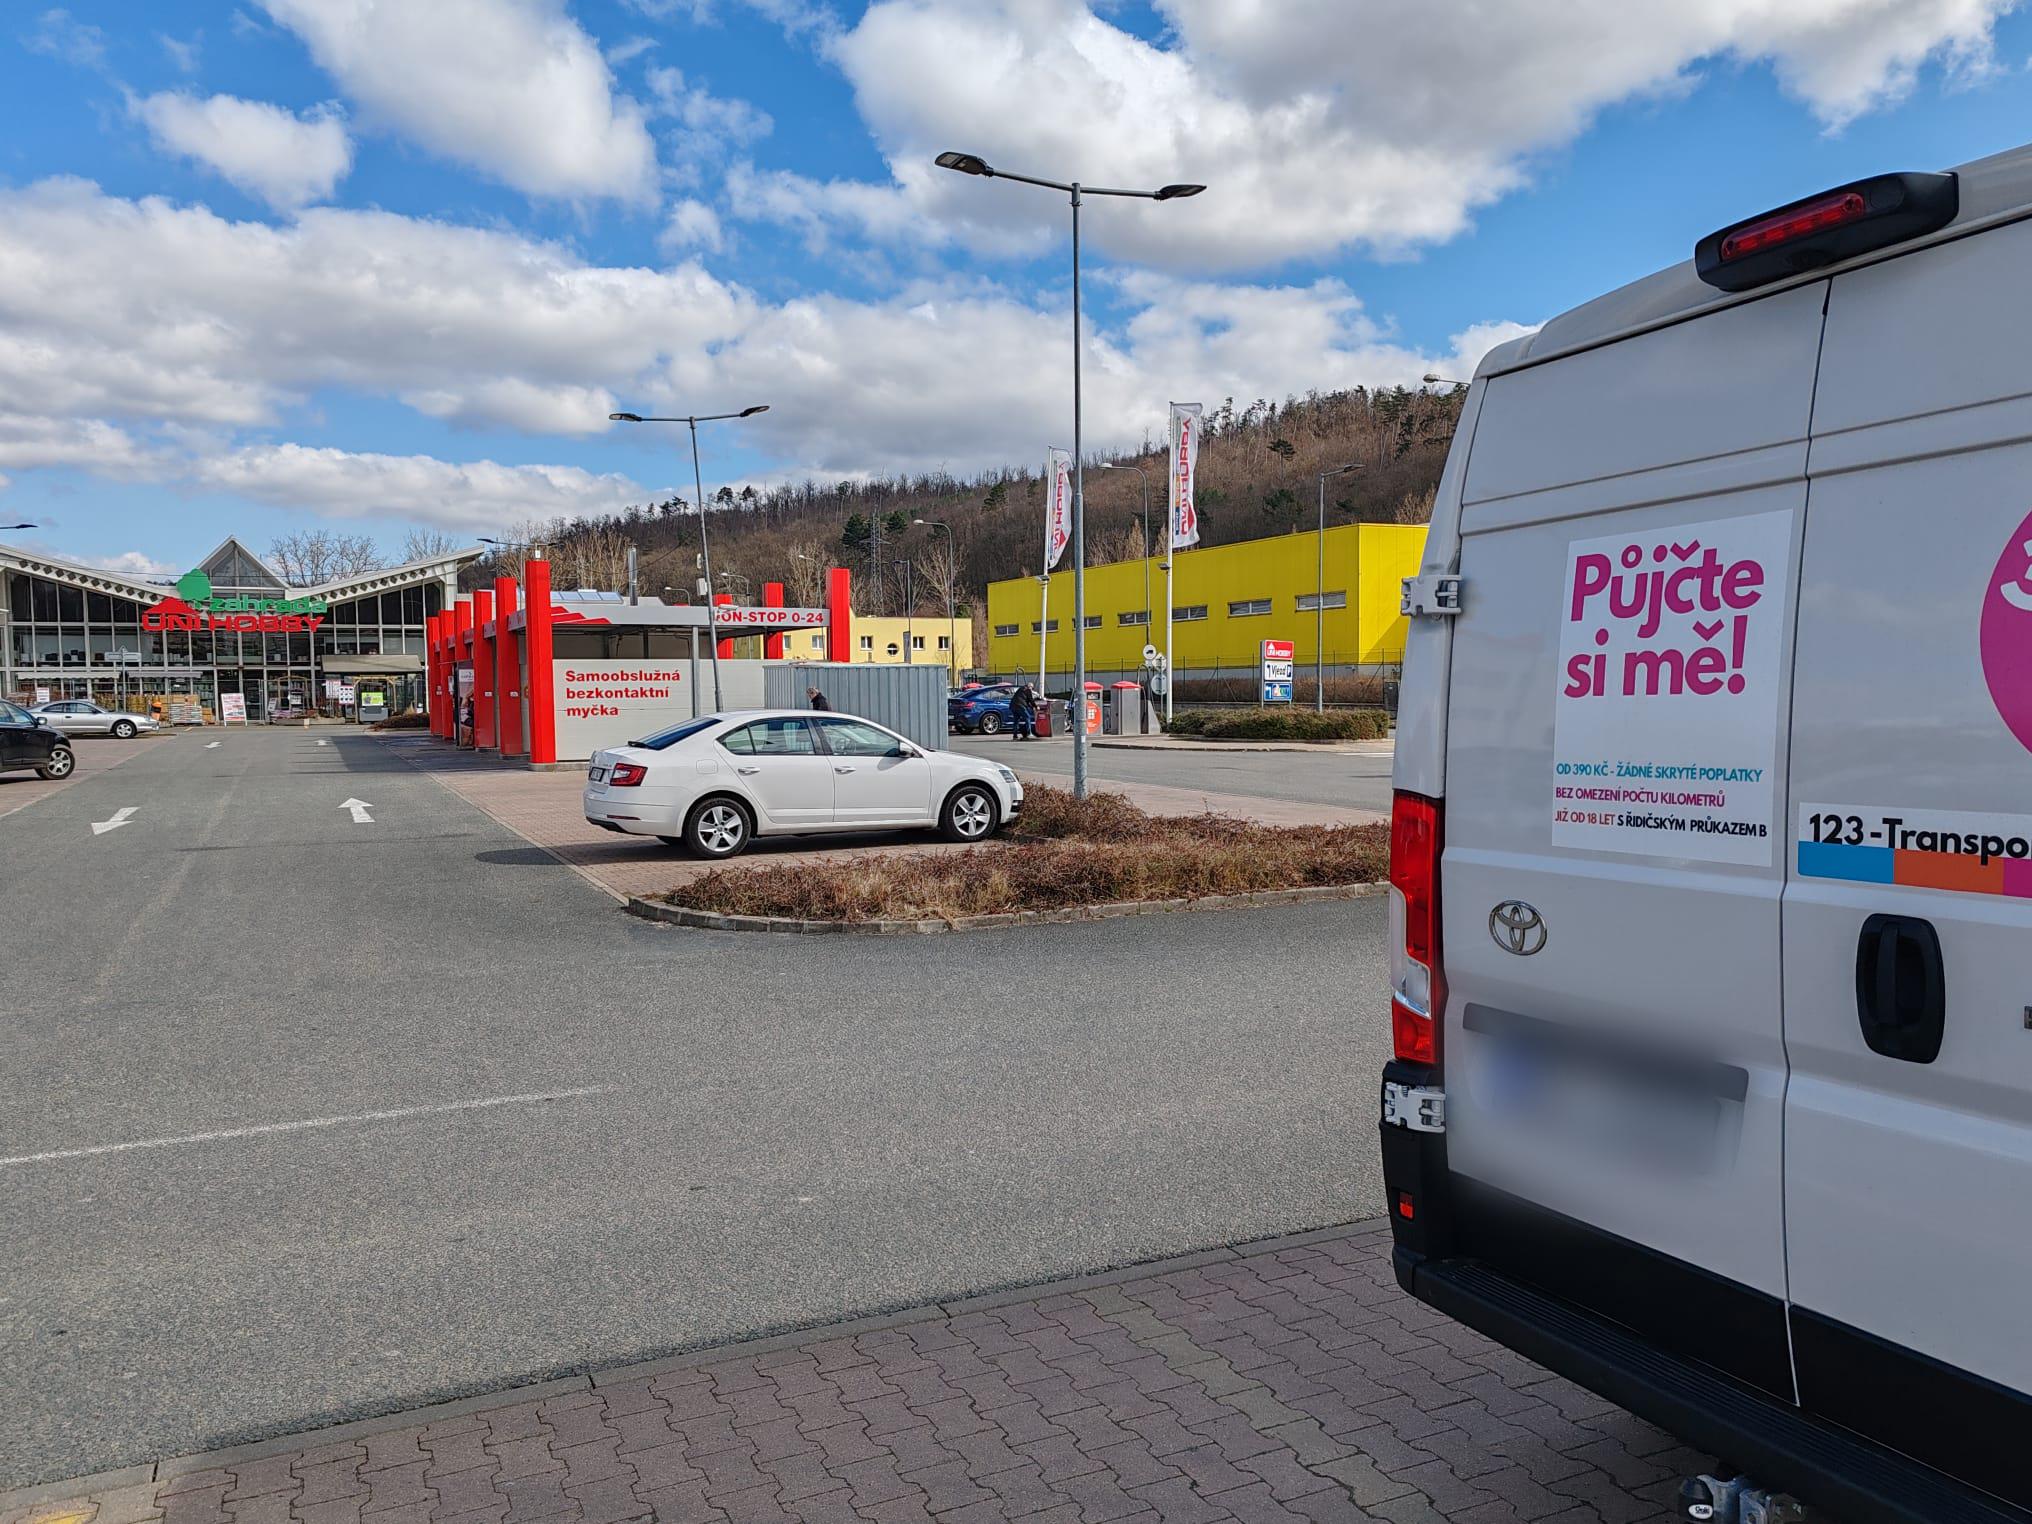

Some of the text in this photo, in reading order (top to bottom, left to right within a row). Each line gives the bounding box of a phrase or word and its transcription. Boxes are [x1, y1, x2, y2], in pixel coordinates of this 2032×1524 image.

[1571, 540, 1764, 638] Půjčte
[209, 594, 328, 613] zahrada
[142, 614, 325, 632] UNI HOBBY
[791, 612, 824, 623] 0-24
[1564, 615, 1748, 698] si mě!
[565, 669, 681, 682] Samoobslužná
[566, 687, 669, 699] bezkontaktní
[567, 704, 619, 718] myčka
[1556, 763, 1571, 775] OD
[1573, 763, 1592, 776] 390
[1594, 761, 1608, 776] KČ
[1616, 761, 1653, 779] ŽÁDNÉ
[1654, 763, 1697, 780] SKRYTÉ
[1699, 767, 1763, 783] POPLATKY
[1556, 785, 1725, 808] BEZ OMEZENÍ POČTU KILOMETRŮ
[1555, 807, 1767, 837] JIŽ OD 18 LET S ŘIDIČSKÝM PRŮKAZEM B
[1810, 813, 2032, 866] 123-Transpo
